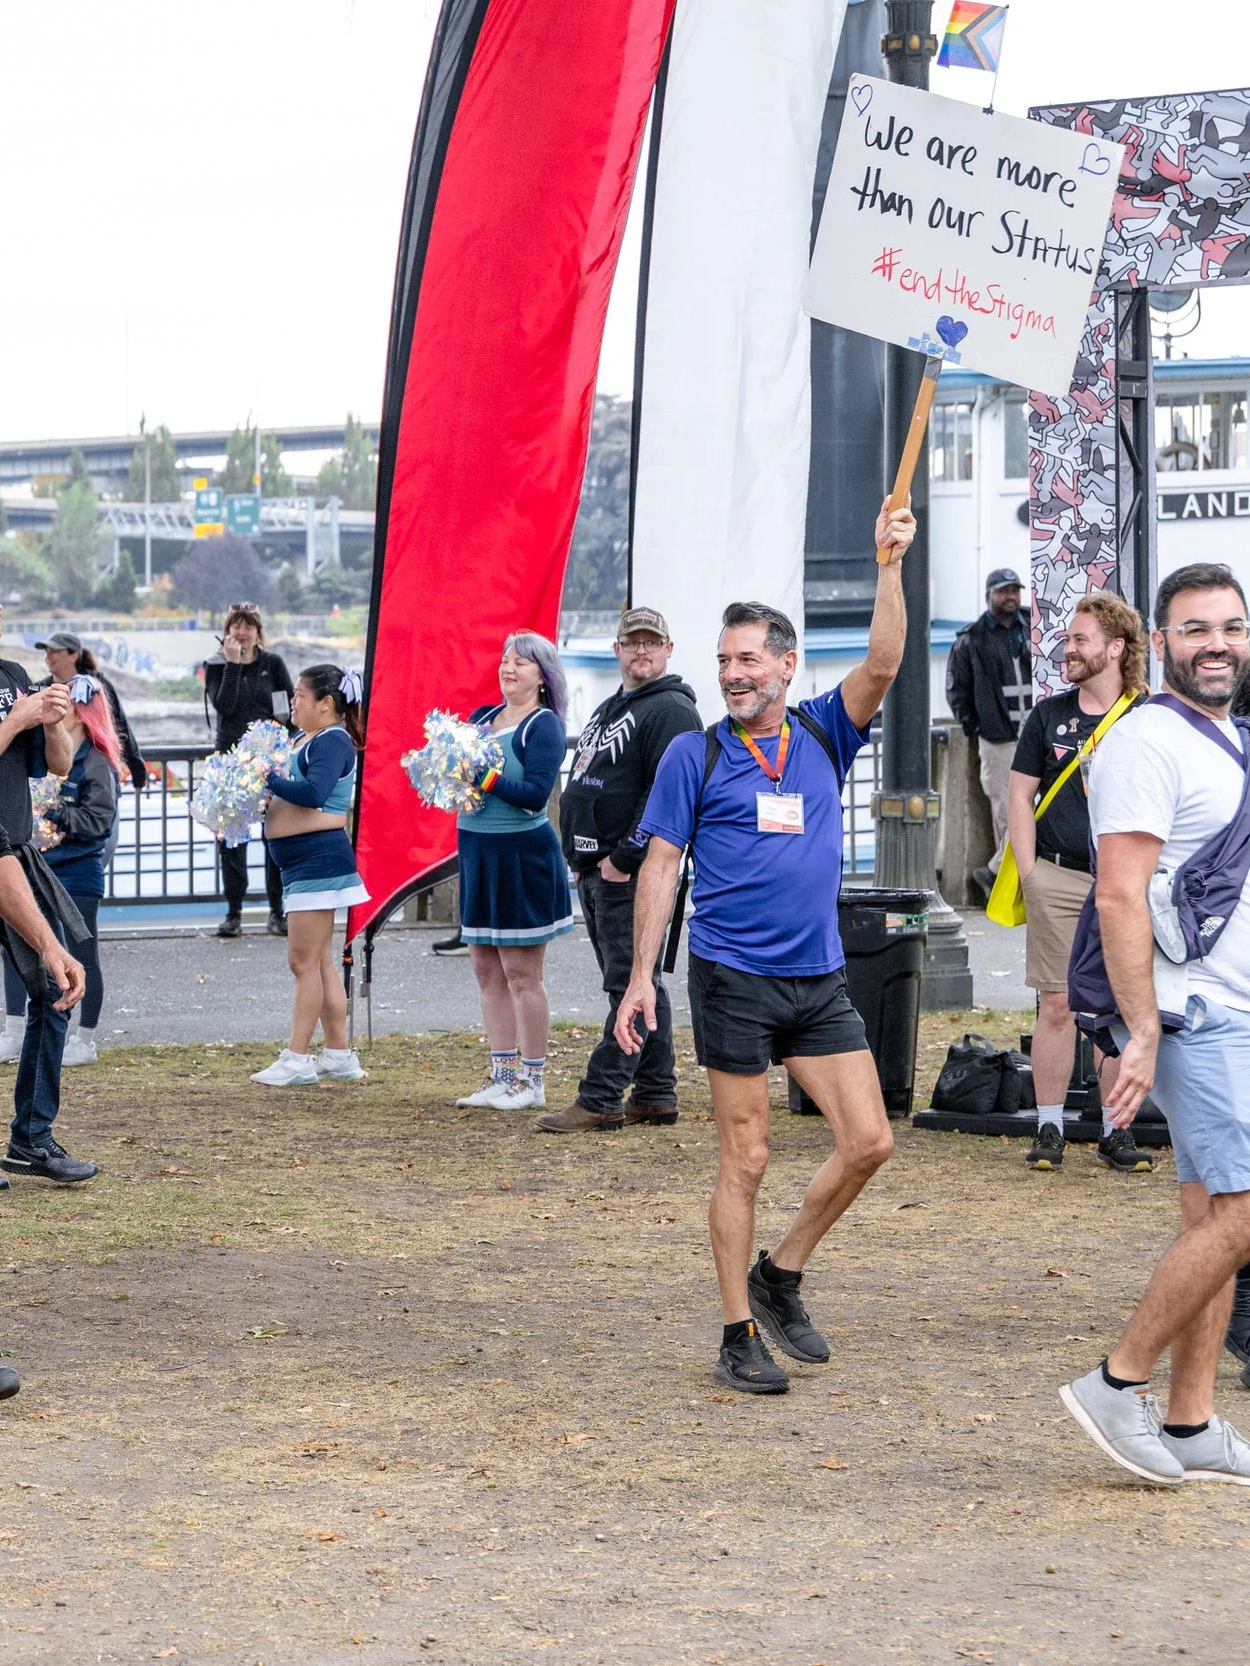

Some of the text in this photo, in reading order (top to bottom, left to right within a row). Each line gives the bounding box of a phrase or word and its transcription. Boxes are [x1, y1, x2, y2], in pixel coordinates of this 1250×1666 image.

[850, 166, 913, 224] than
[928, 197, 984, 238] our
[864, 115, 1077, 208] We are more
